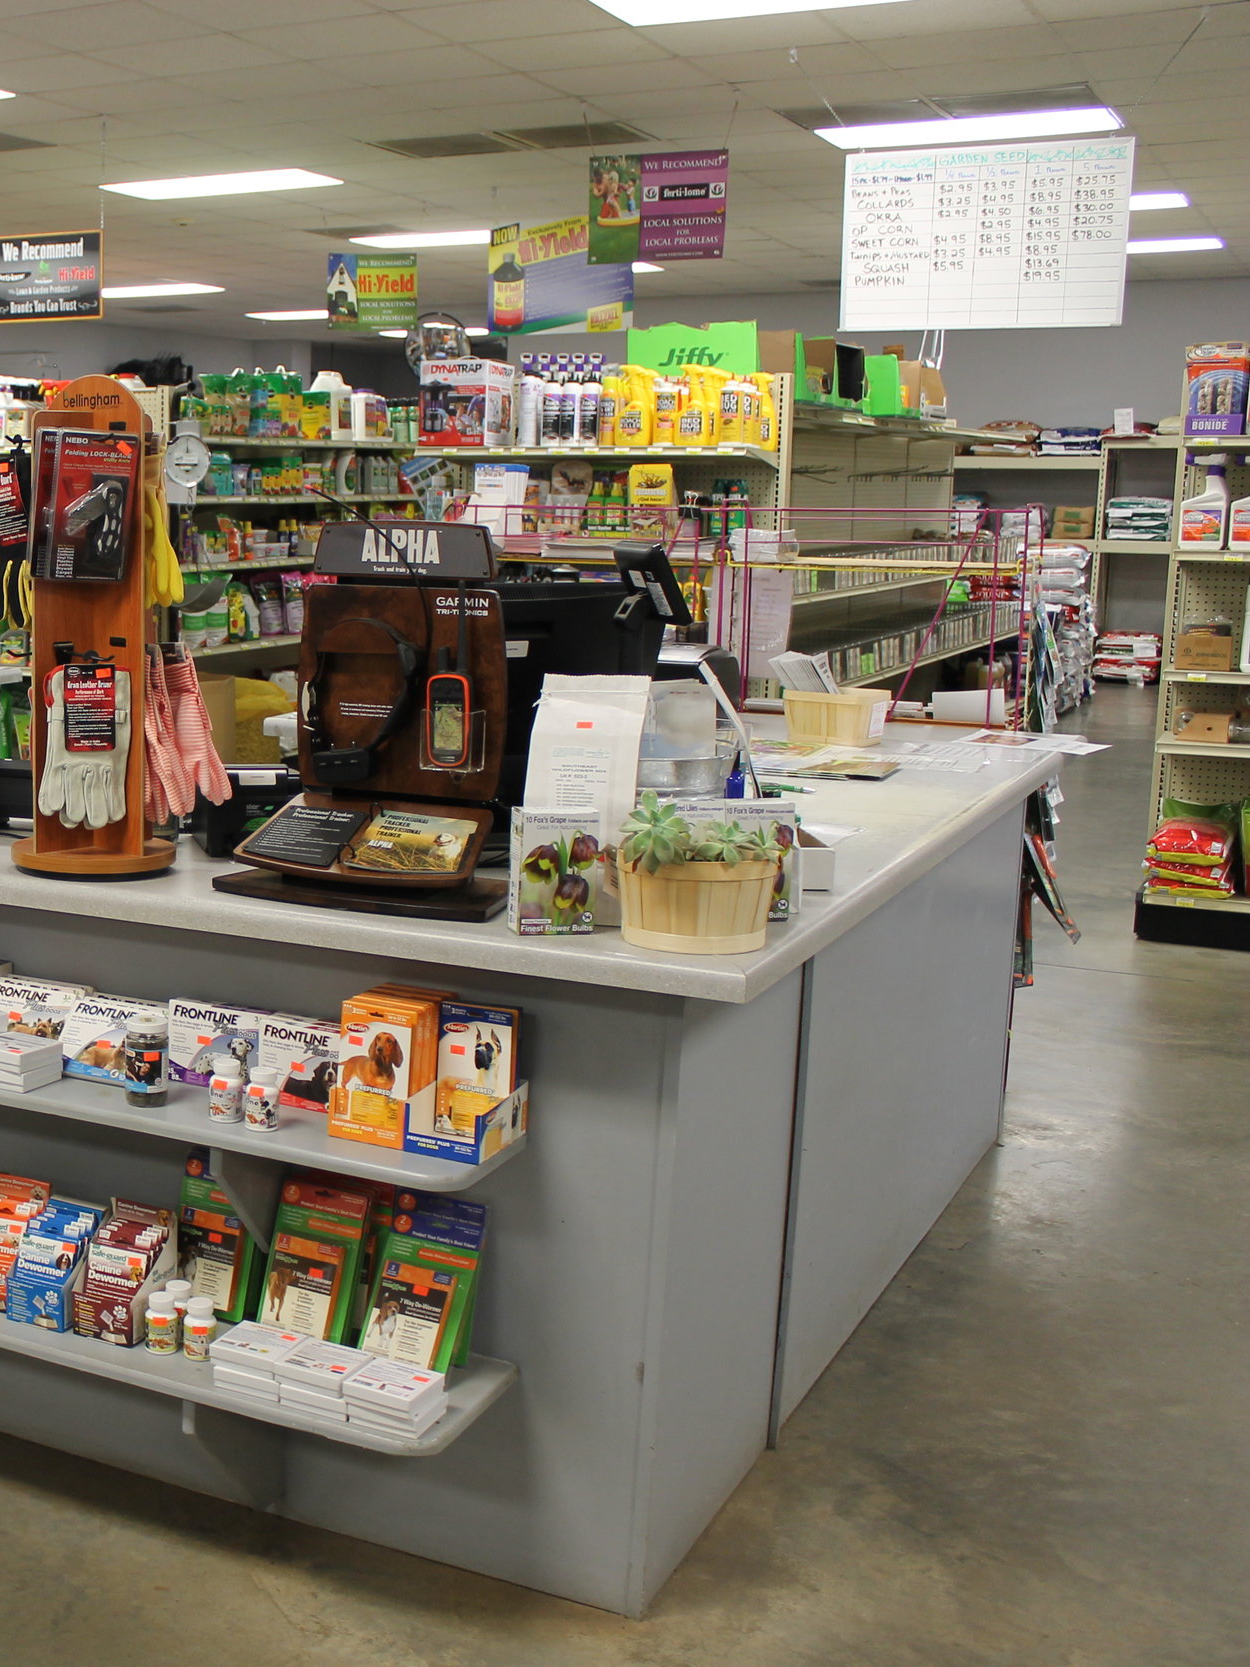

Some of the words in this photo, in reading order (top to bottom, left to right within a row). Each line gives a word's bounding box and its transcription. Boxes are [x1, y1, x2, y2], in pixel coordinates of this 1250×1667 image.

[644, 160, 659, 170] WE
[662, 158, 722, 169] RECOMMEND
[939, 153, 989, 166] GARDEN
[994, 151, 1026, 163] SEED
[983, 180, 1016, 191] $3.95
[1031, 177, 1064, 189] $5.95
[1075, 174, 1116, 186] $25.75
[663, 187, 707, 198] ferti-lome
[939, 183, 973, 194] $2.95
[1074, 188, 1115, 200] $38.95
[938, 196, 971, 207] $3.25
[982, 193, 1014, 204] $4.95
[1030, 190, 1062, 202] $8.95
[856, 198, 915, 210] COLLARDS
[1073, 202, 1114, 213] $30.00
[937, 209, 969, 219] $2.95
[981, 207, 1011, 217] $4.50
[1028, 205, 1060, 216] $6.95
[644, 218, 670, 228] LOCAL
[673, 216, 722, 226] SOLUTIONS
[865, 213, 903, 224] OKRA
[980, 219, 1011, 230] $2.95
[1027, 217, 1060, 229] $4.95
[1072, 214, 1114, 226] $20.75
[493, 223, 519, 247] NOW
[852, 224, 868, 236] OP
[877, 223, 913, 235] CORN
[1026, 230, 1061, 241] $15.95
[1071, 229, 1112, 241] $78.00
[518, 224, 588, 264] Hi-Yield
[645, 238, 672, 247] LOCAL
[674, 236, 719, 246] PROBLEMS
[851, 238, 884, 249] SWEET
[890, 237, 919, 248] CORN
[934, 233, 967, 246] $4.95
[979, 232, 1011, 244] $8.95
[2, 241, 20, 262] We
[21, 236, 84, 261] Recommend
[933, 248, 966, 258] $3.25
[979, 245, 1011, 257] $4.95
[1025, 244, 1058, 256] $8.95
[863, 262, 910, 274] SQUASH
[933, 260, 964, 271] $5.95
[1024, 258, 1060, 269] $13.69
[58, 266, 96, 281] Hi-Yield
[1023, 270, 1060, 281] $19.95
[358, 273, 416, 293] Hi-Yield
[854, 275, 905, 287] PUMPKIN
[10, 300, 34, 314] Brands
[34, 300, 46, 313] You
[46, 298, 58, 312] Can
[58, 298, 78, 312] Trust
[657, 346, 726, 367] Jiffy
[430, 364, 483, 377] DYNATRAP
[62, 392, 120, 410] bellingham
[1192, 421, 1228, 430] BONIDE
[66, 436, 89, 445] NEBO
[64, 450, 89, 458] Folding
[361, 528, 440, 564] ALPHA
[80, 680, 98, 688] Leather
[292, 812, 329, 820] Professional
[388, 814, 430, 824] PROFESSIONAL
[526, 816, 532, 824] 10
[533, 816, 548, 824] Fox's
[550, 816, 568, 825] Grape
[384, 820, 410, 828] TRACKER
[376, 830, 402, 838] TRAINER
[380, 826, 422, 835] PROFESSIONAL
[368, 840, 394, 848] ALPHA
[768, 911, 788, 919] Bulbs
[520, 924, 544, 932] Finest
[546, 924, 571, 932] Flower
[572, 924, 593, 932] Bulbs
[75, 1002, 138, 1020] FRONTLINE
[174, 1004, 239, 1026] FRONTLINE
[213, 1022, 238, 1036] Plus
[238, 1030, 257, 1040] DOGS
[264, 1024, 330, 1047] FRONTLINE
[303, 1043, 328, 1058] Plus
[354, 1084, 391, 1096] PREFURRED
[455, 1084, 494, 1095] PREFURRED
[331, 1120, 360, 1130] PREFURRED
[360, 1124, 374, 1132] PLUS
[406, 1134, 436, 1146] PREFURRED
[436, 1140, 450, 1148] PLUS
[191, 1160, 198, 1168] 2
[289, 1184, 295, 1194] 2
[404, 1194, 410, 1203] 2
[400, 1216, 407, 1224] 2
[20, 1239, 56, 1251] safe-guard
[19, 1250, 50, 1265] Canine
[91, 1249, 127, 1262] safe-guard
[17, 1258, 66, 1278] Dewormer
[90, 1262, 122, 1276] Canine
[88, 1270, 139, 1289] Dewormer
